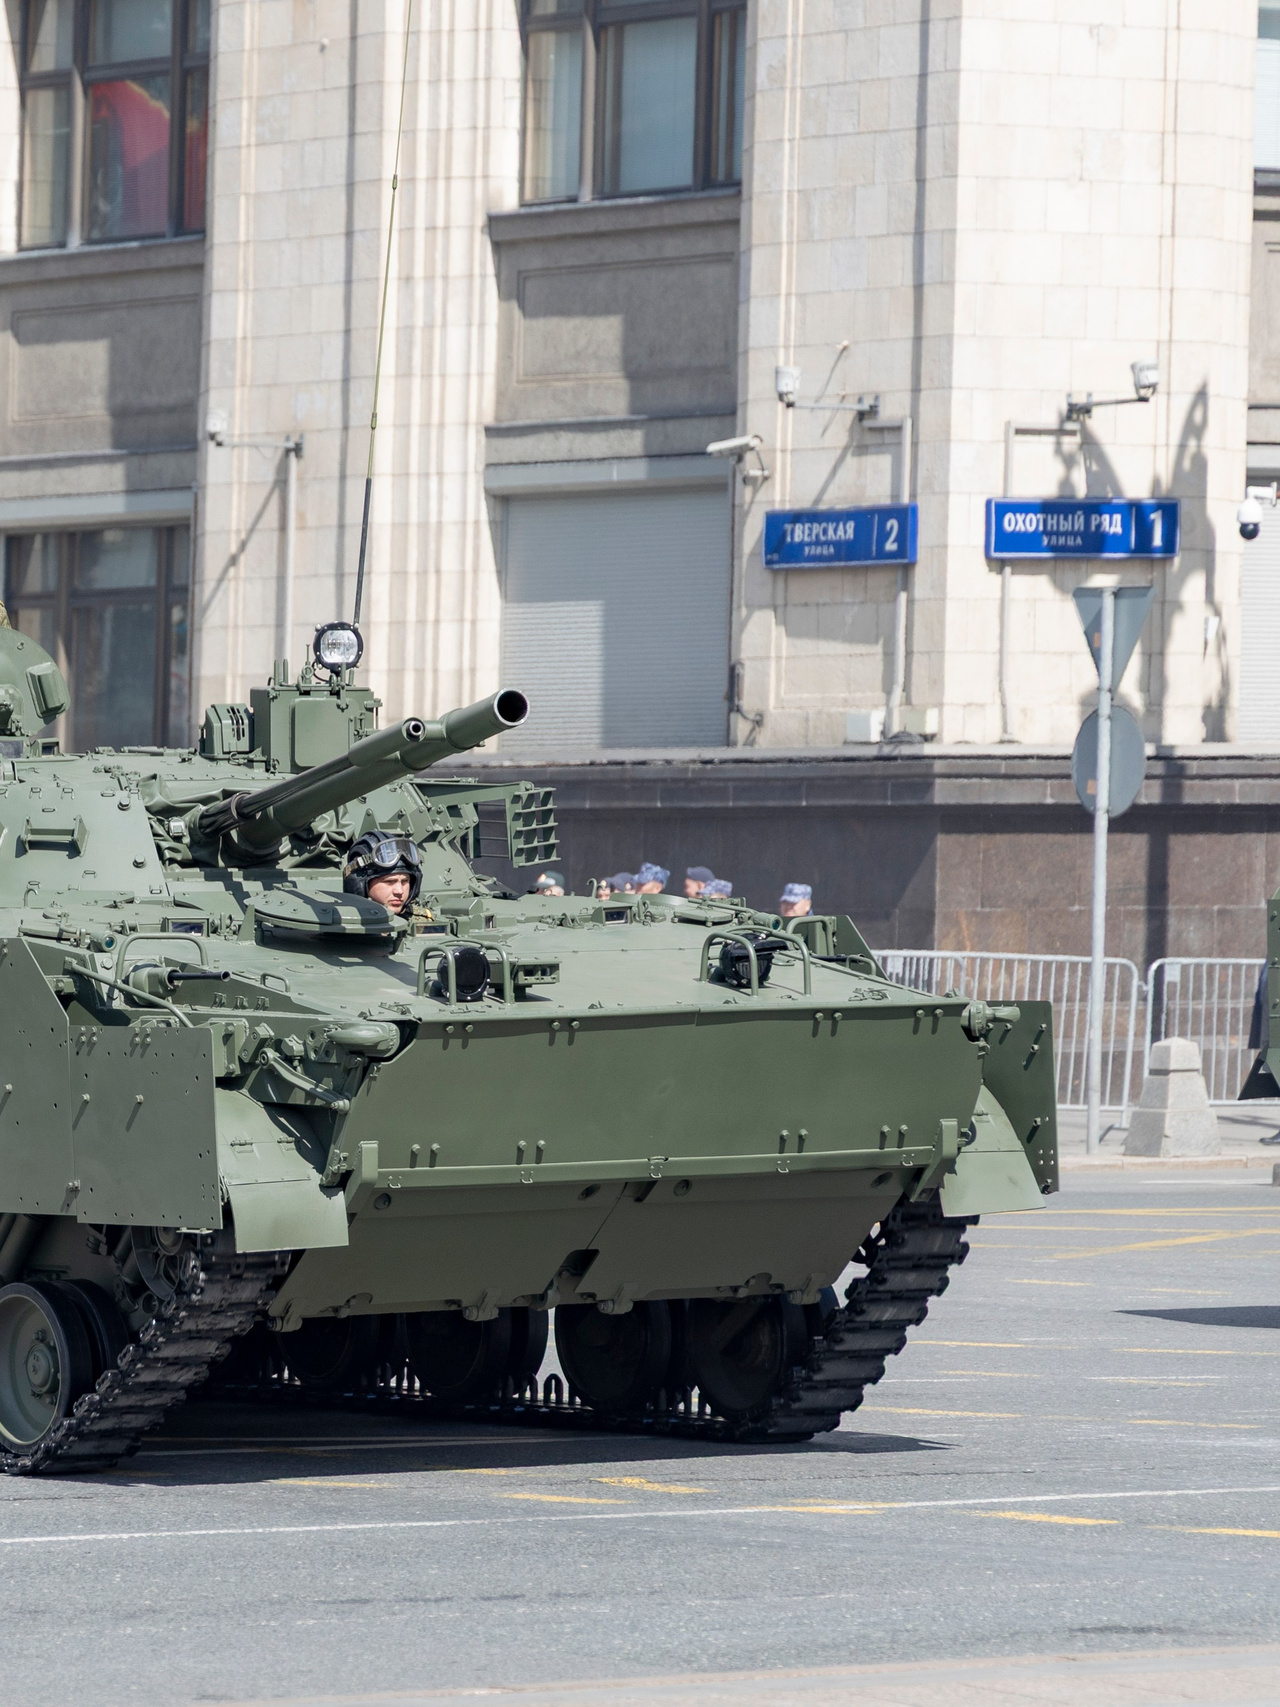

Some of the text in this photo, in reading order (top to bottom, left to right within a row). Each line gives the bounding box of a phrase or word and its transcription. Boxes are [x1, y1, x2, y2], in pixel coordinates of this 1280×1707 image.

[784, 520, 855, 543] ТВЕРСКАЯ
[1003, 510, 1123, 535] ОХОТНЫЙ РЯД
[1149, 509, 1163, 547] 1
[884, 518, 899, 552] 2
[1042, 535, 1083, 547] УЛИЦА
[804, 544, 835, 557] УЛИЦА
